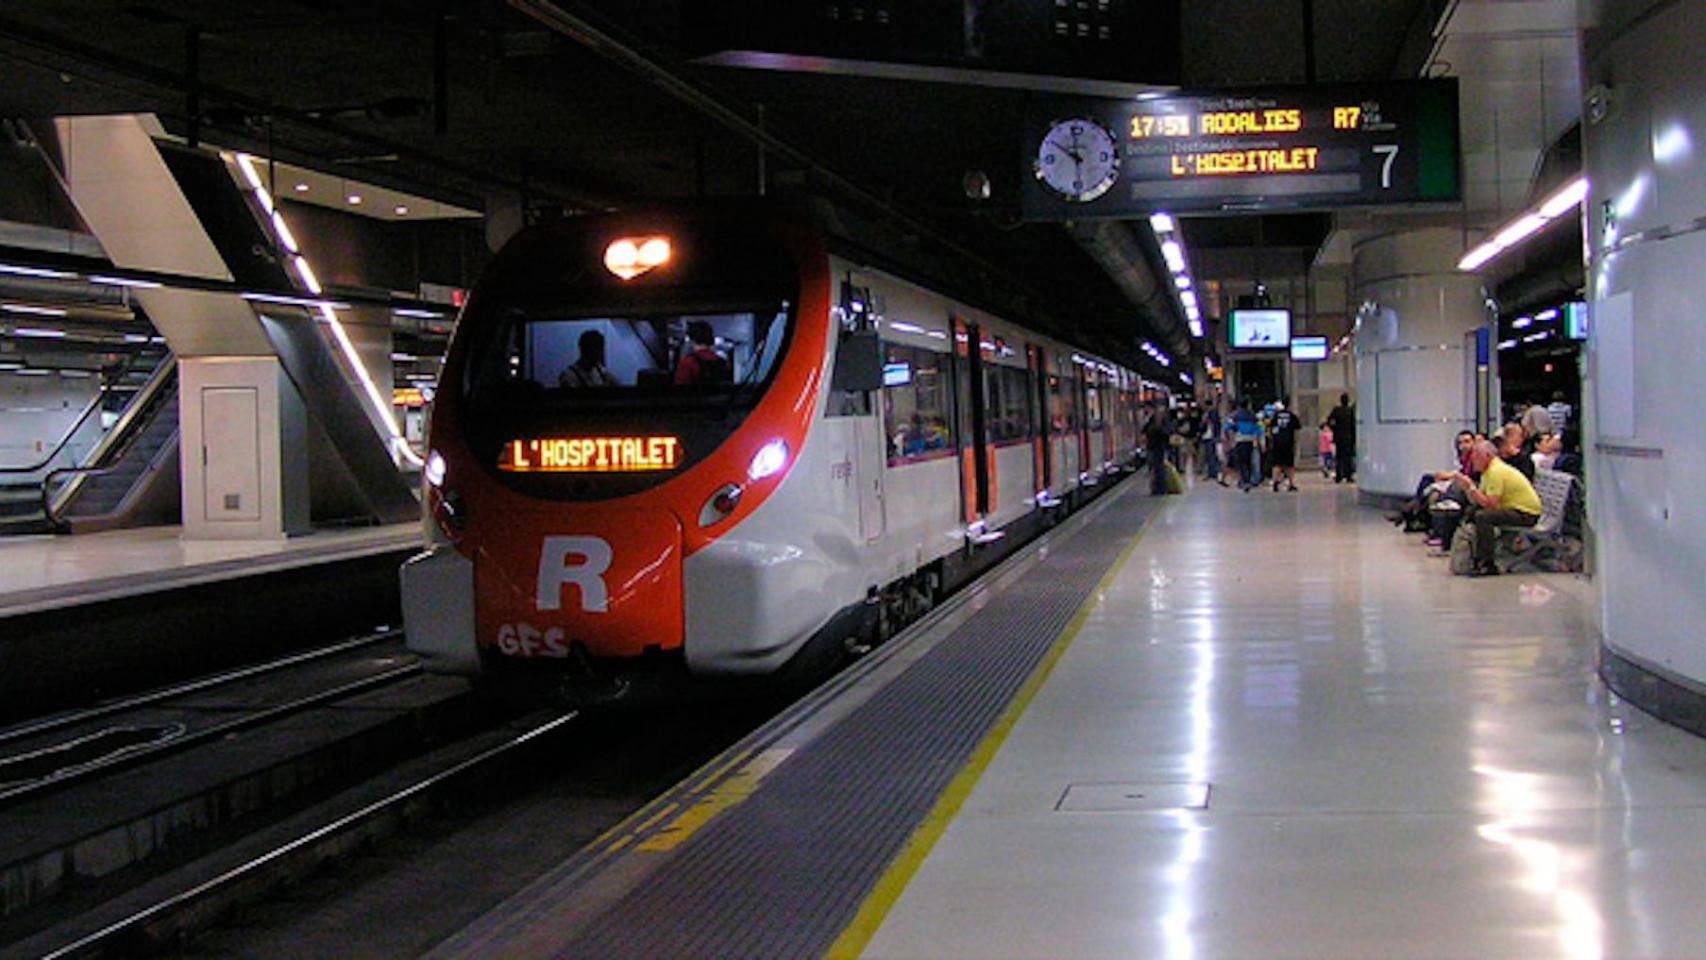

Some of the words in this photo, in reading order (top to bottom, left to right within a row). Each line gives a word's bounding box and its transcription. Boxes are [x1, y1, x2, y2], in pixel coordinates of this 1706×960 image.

[1201, 109, 1301, 134] RODALIES
[1333, 107, 1360, 129] R7
[1171, 147, 1317, 176] L'HOSPITALET
[1372, 144, 1399, 188] 7
[513, 437, 677, 467] L'HOSPITALET
[535, 534, 613, 613] R
